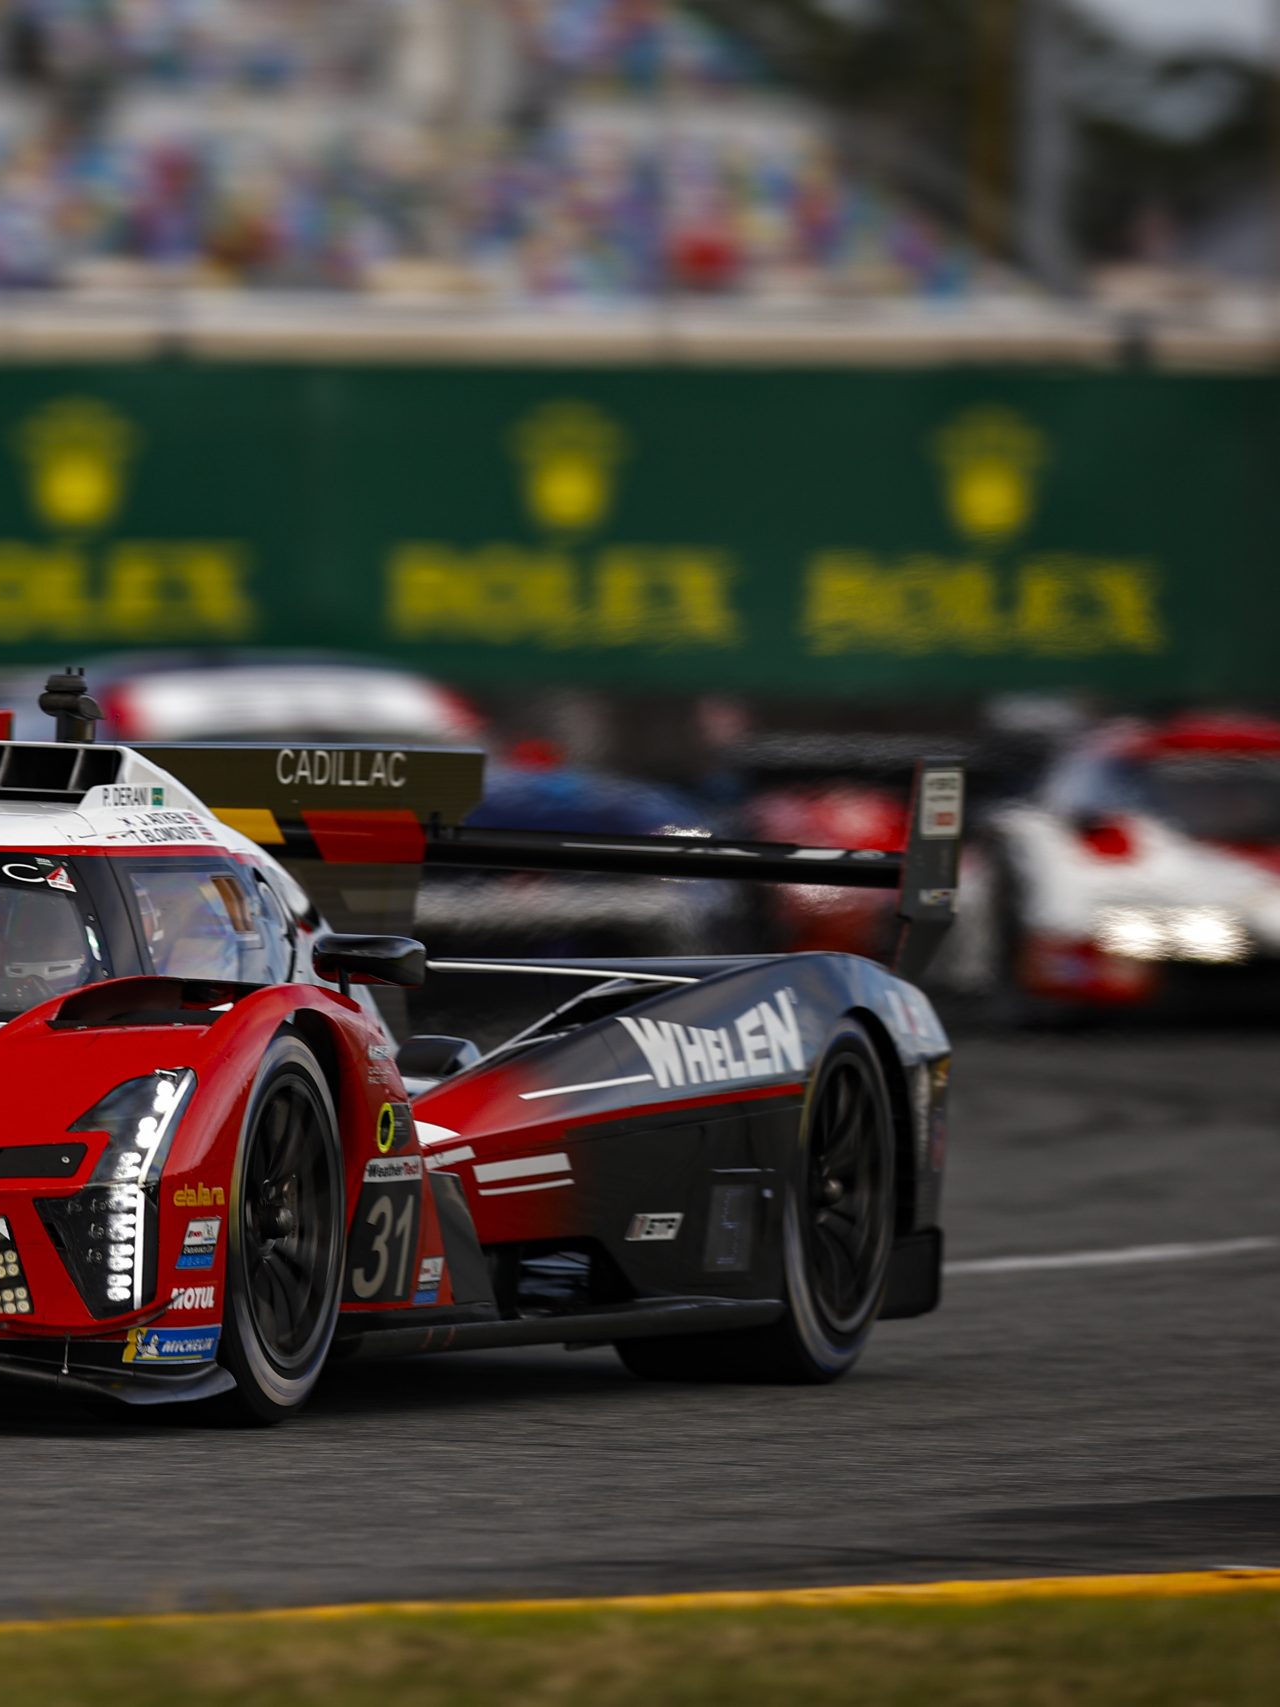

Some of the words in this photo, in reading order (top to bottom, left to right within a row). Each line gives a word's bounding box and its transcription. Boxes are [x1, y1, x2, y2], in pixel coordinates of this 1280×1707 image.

[387, 544, 738, 652] ROLEX
[806, 550, 1164, 656] ROLEX
[276, 749, 407, 787] CADILLAC
[615, 989, 806, 1089] WHELEN
[352, 1195, 415, 1298] 31
[161, 1338, 215, 1353] MICHELIN
[167, 1286, 215, 1310] MOTUL
